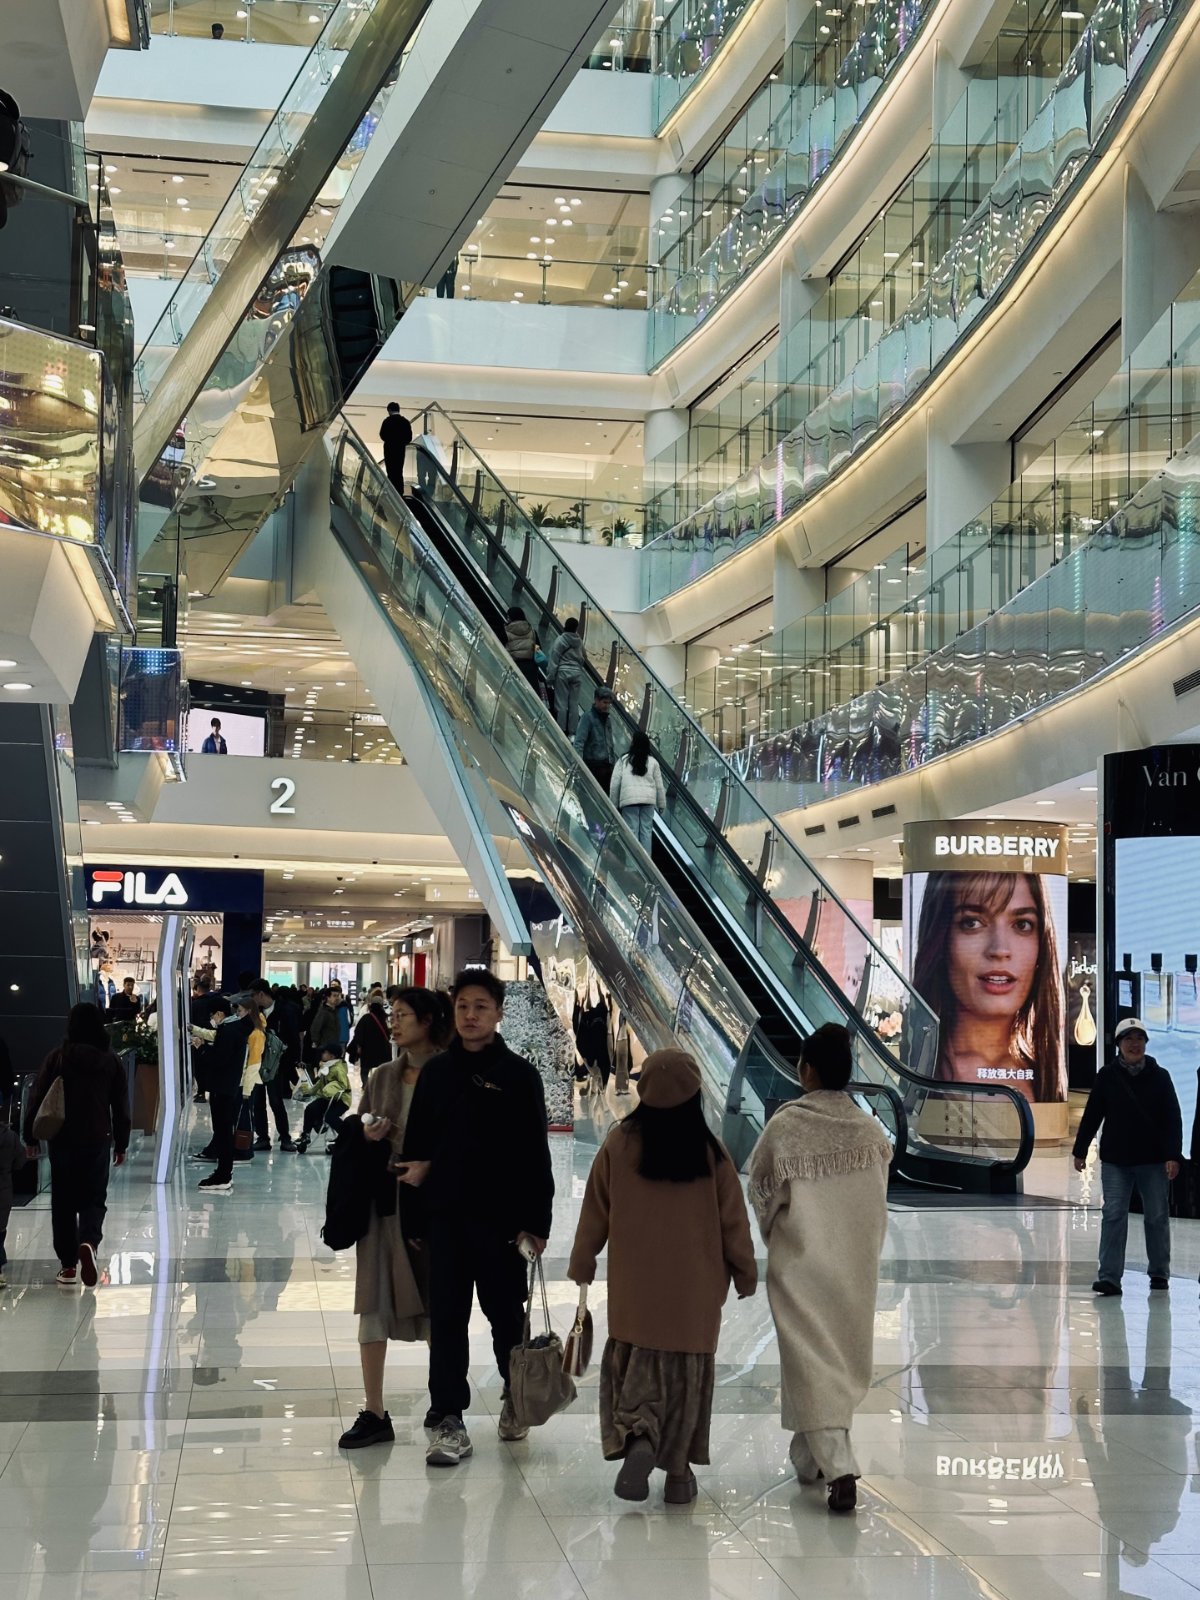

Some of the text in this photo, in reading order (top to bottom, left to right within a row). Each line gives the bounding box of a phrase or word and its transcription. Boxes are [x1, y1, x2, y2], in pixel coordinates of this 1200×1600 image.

[1142, 765, 1187, 787] Van
[270, 777, 295, 814] 2
[935, 836, 1060, 858] BURBERRY
[92, 871, 189, 905] FILA
[976, 1067, 1034, 1080] 释放强大自我
